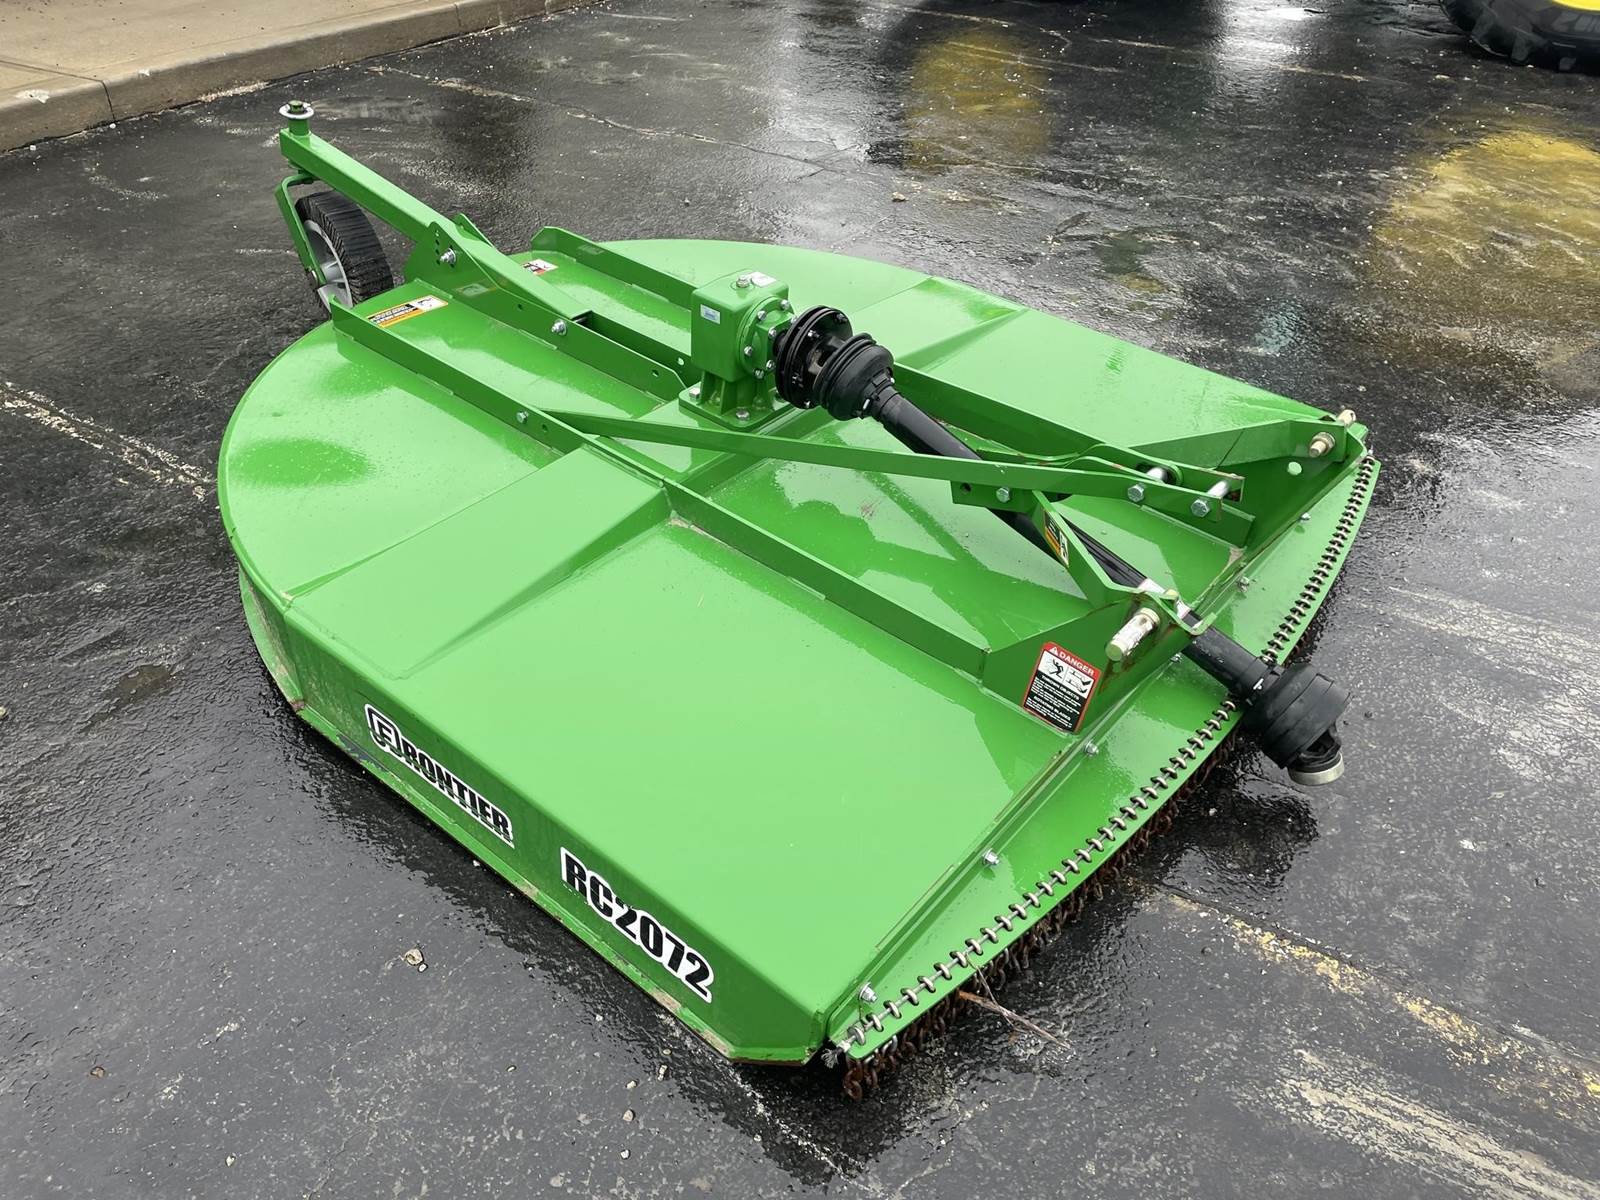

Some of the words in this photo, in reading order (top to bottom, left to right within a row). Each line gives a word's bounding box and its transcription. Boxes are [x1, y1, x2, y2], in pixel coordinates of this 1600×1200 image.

[1059, 651, 1095, 676] DANGER
[365, 704, 514, 848] FRONTIER
[562, 849, 712, 1001] RC2072
